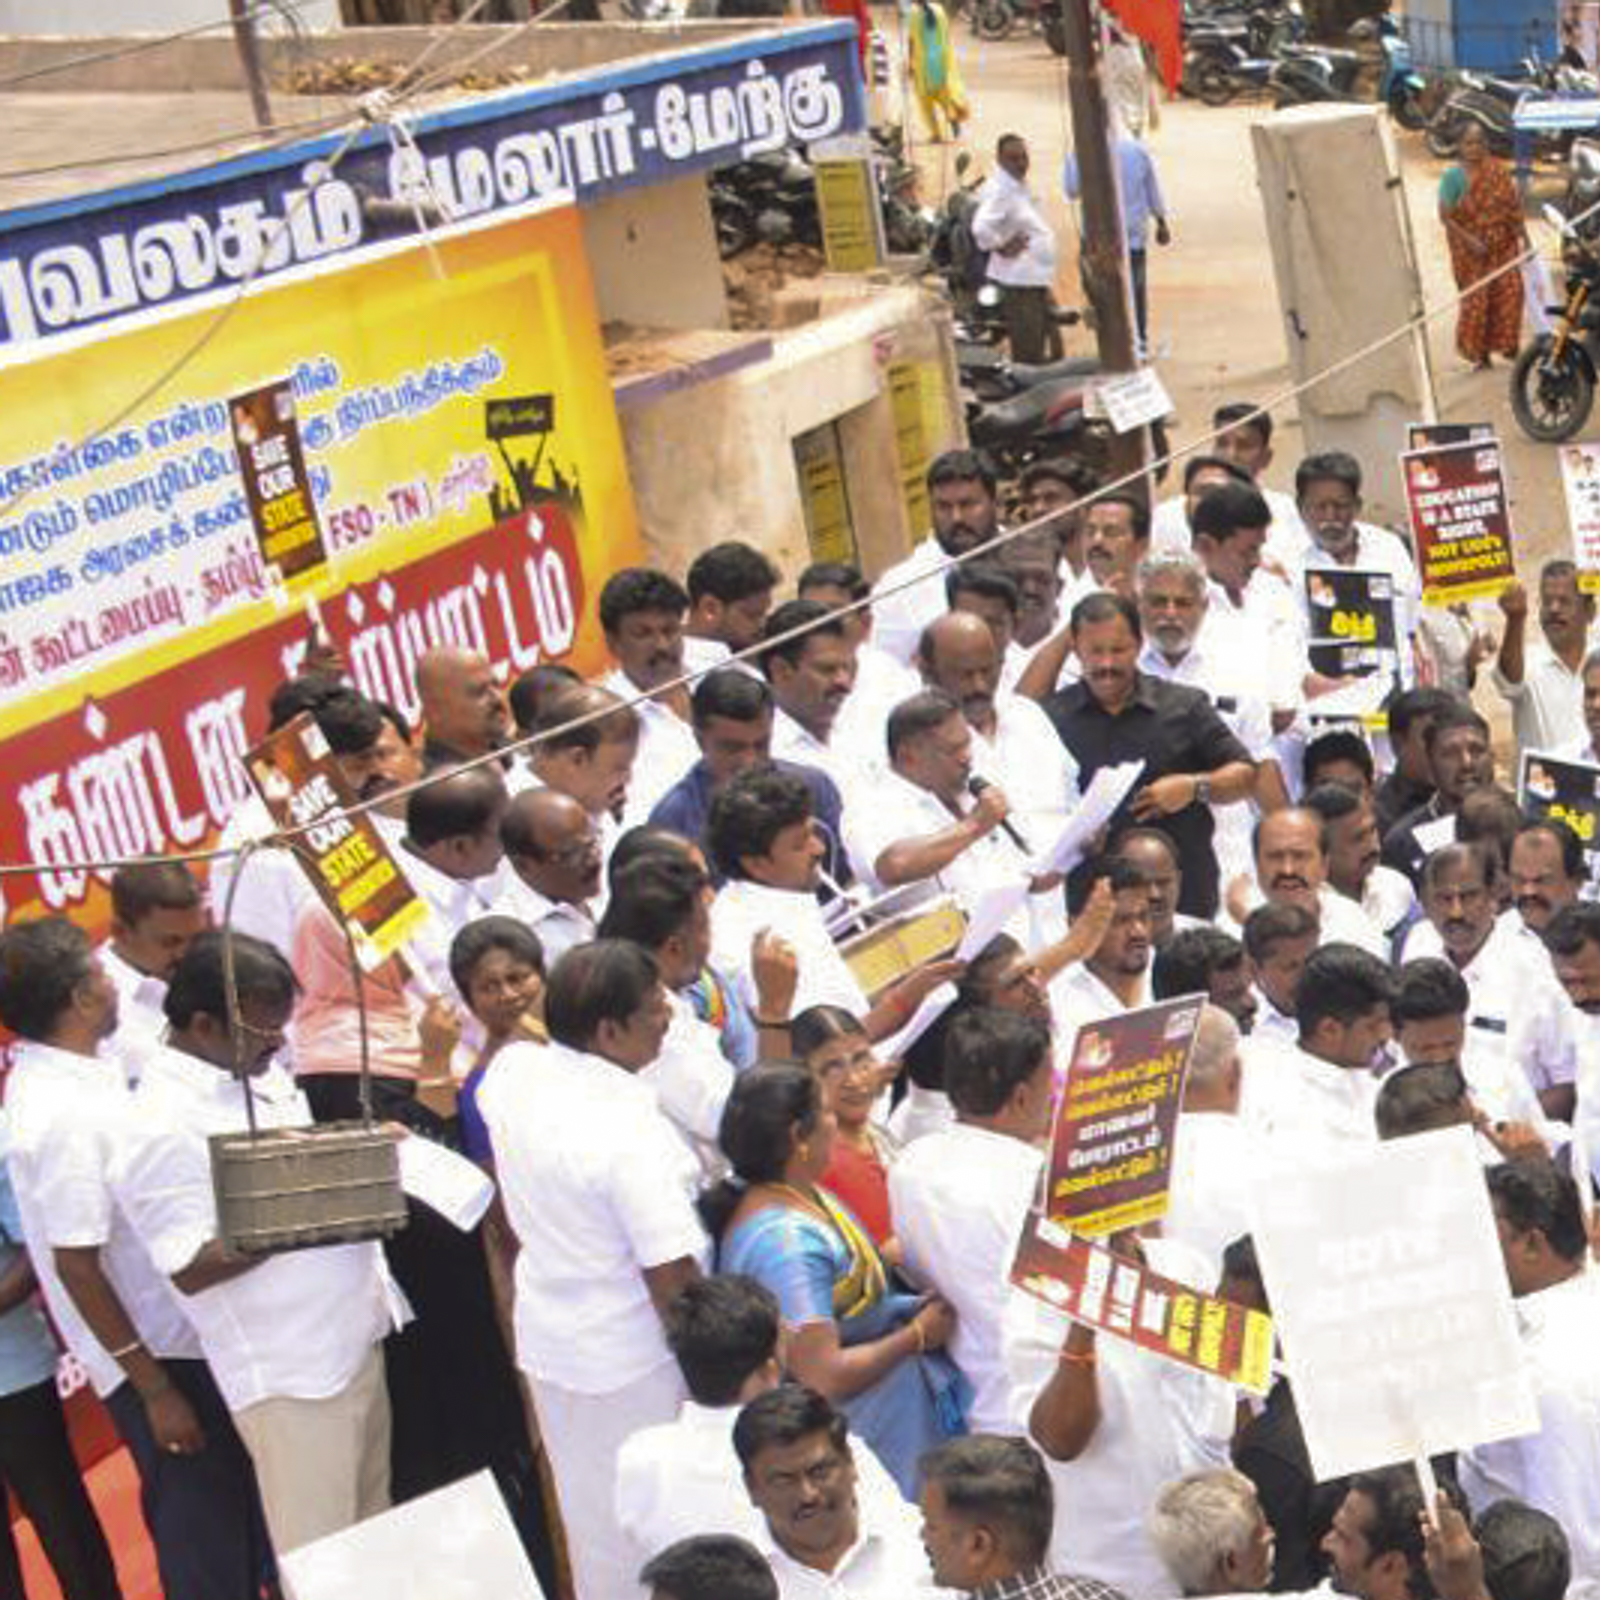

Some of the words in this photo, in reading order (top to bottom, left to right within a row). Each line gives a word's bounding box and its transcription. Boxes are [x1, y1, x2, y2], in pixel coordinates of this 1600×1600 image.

[328, 505, 375, 550] FSO
[283, 514, 580, 726] ர்ப்பாட்டம்
[319, 832, 379, 887] STATE
